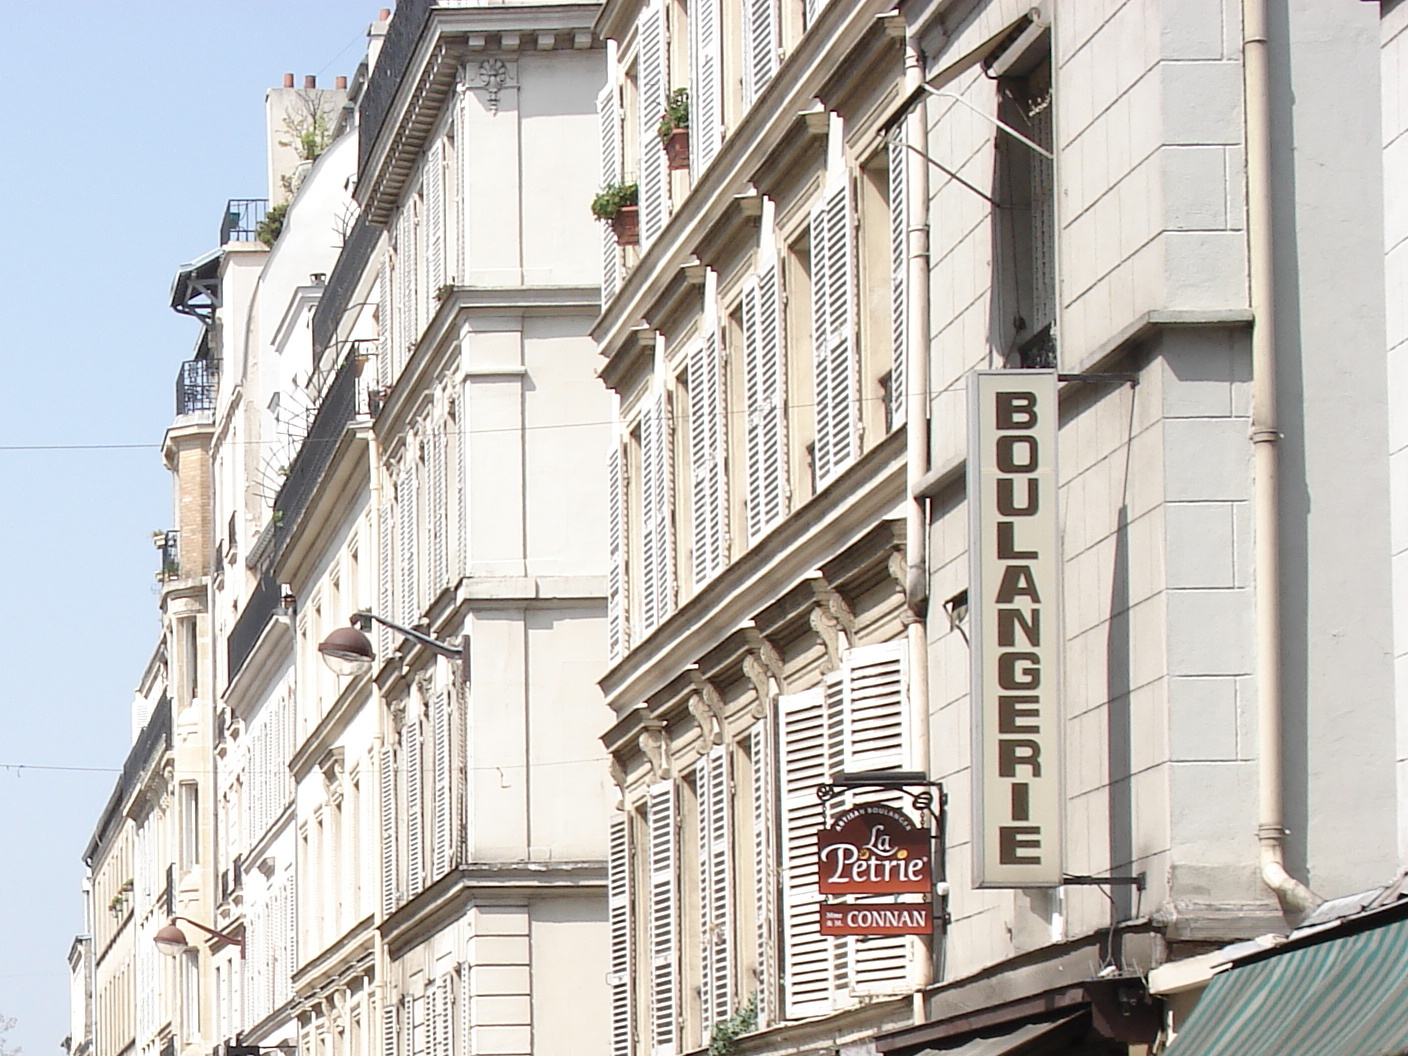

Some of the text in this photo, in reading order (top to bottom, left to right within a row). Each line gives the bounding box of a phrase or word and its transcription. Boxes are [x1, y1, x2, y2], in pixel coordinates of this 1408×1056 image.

[995, 391, 1042, 866] BOULANGERIE
[834, 808, 866, 832] ARTISAN
[863, 825, 898, 856] La
[847, 911, 926, 927] CONNAN
